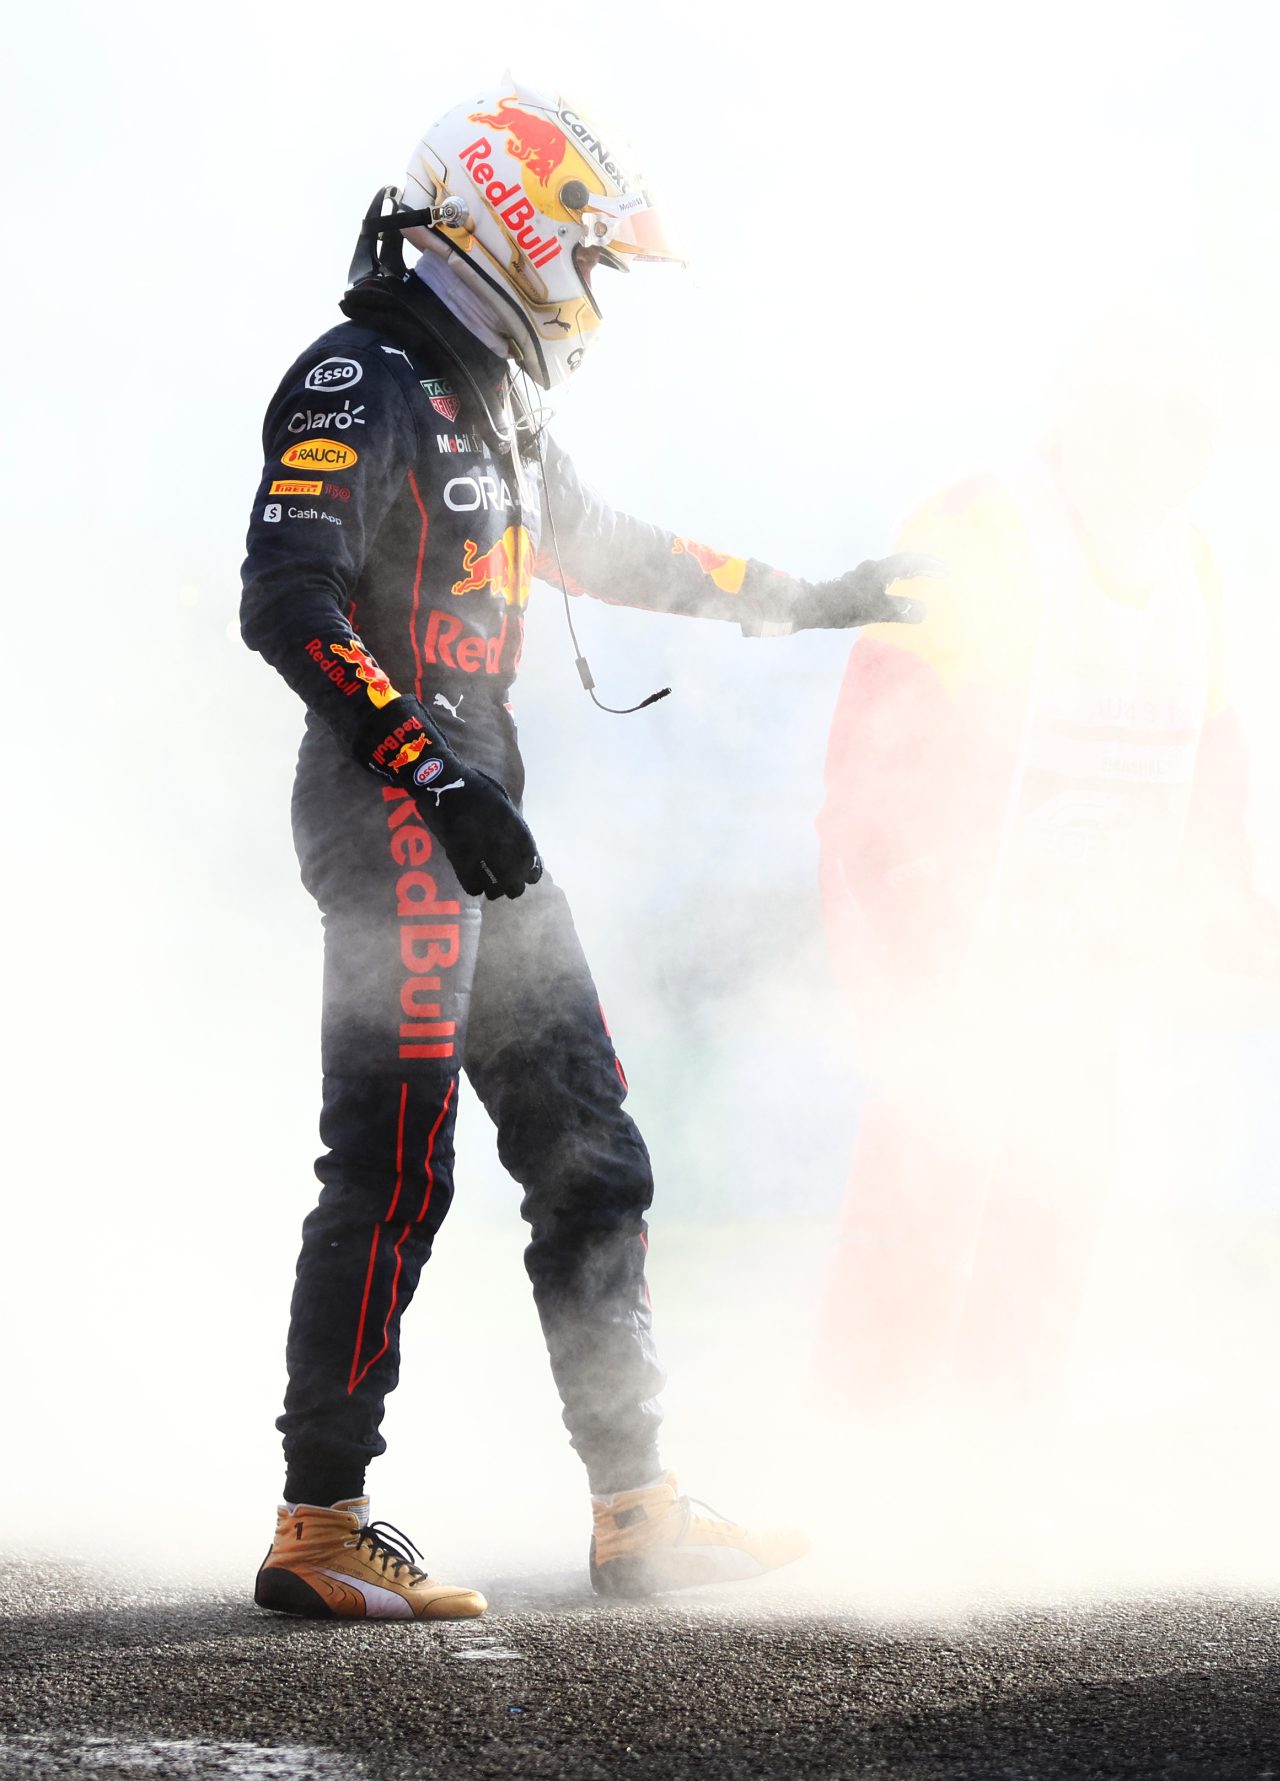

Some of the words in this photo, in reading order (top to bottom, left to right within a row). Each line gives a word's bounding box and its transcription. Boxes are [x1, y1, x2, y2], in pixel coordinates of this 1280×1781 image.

[423, 382, 452, 396] TAG
[287, 409, 353, 433] Claro
[437, 434, 471, 453] Mobil
[297, 447, 348, 464] RAUCH
[274, 482, 319, 494] PIRELLI
[443, 476, 524, 512] ORA
[287, 507, 318, 519] Cash
[320, 511, 342, 526] App
[424, 609, 508, 674] Red
[294, 1521, 304, 1541] 1
